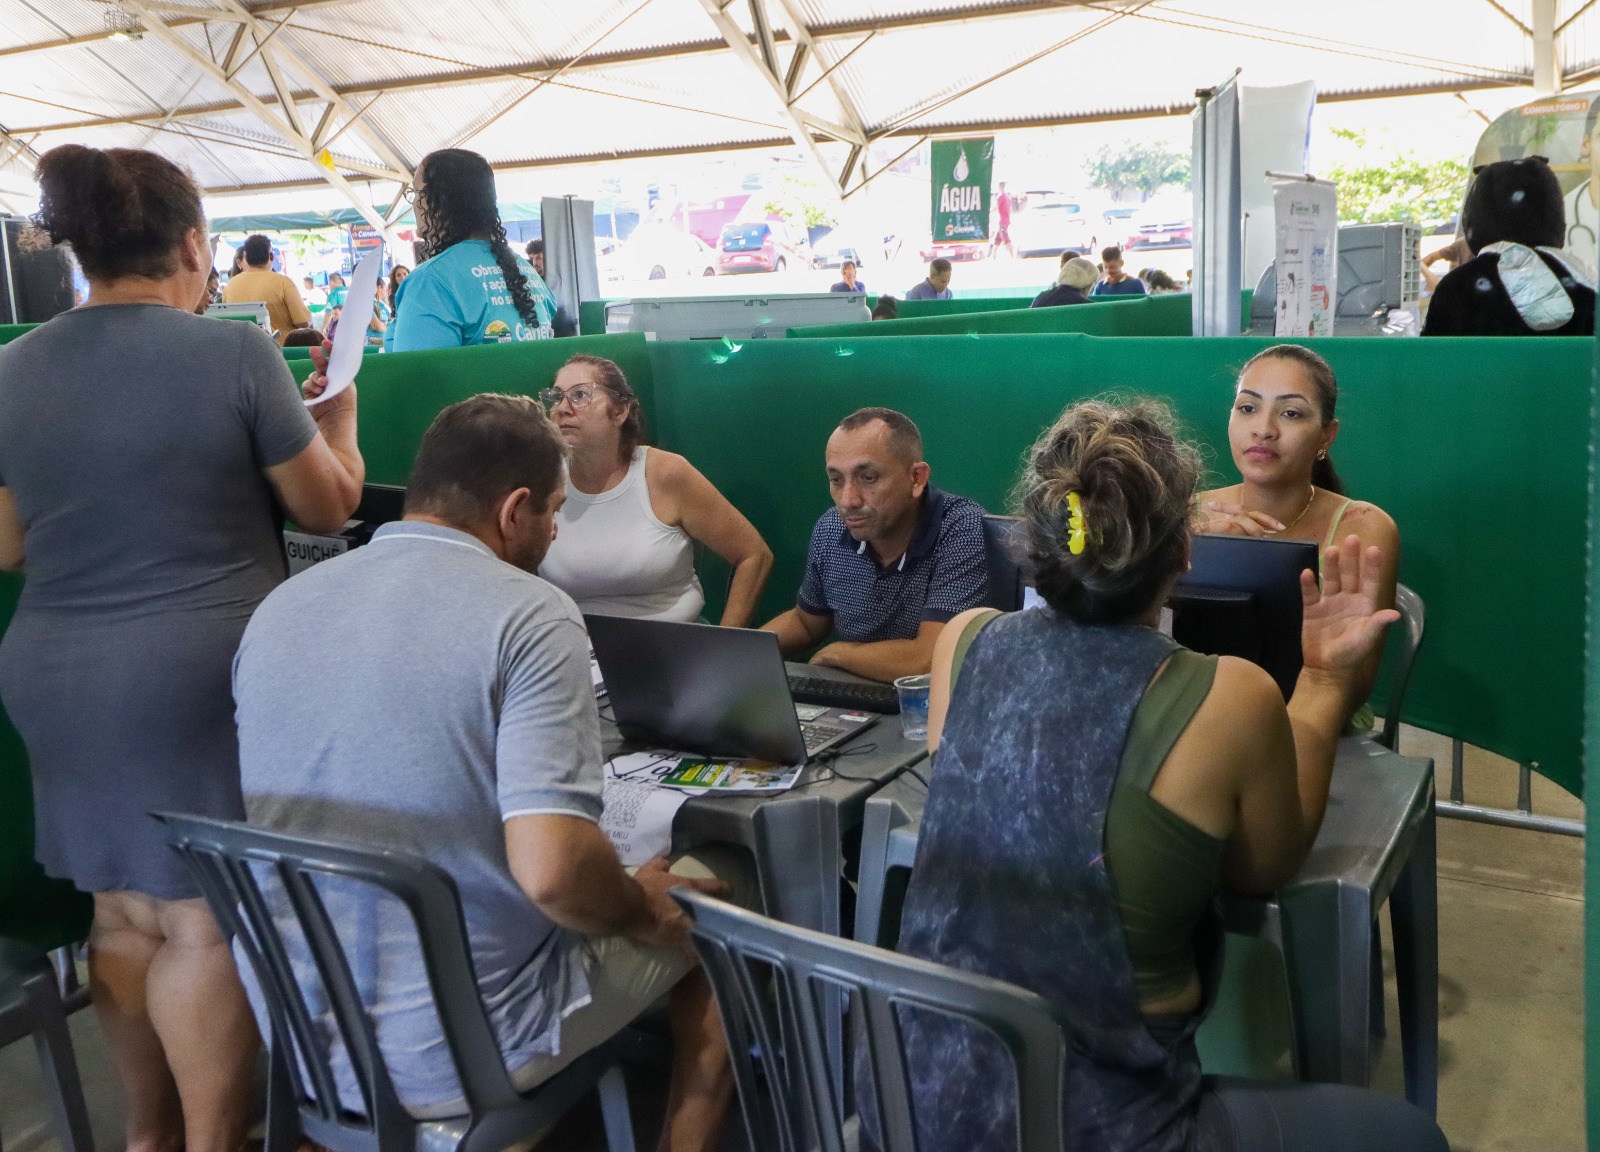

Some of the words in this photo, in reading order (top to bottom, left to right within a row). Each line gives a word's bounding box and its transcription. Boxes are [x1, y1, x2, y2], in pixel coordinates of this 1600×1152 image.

[1524, 102, 1580, 114] CONSULTÓRIO
[940, 183, 982, 213] ÁGUA
[490, 295, 504, 306] no
[287, 541, 341, 562] GUICHÊ
[612, 830, 629, 840] MEU
